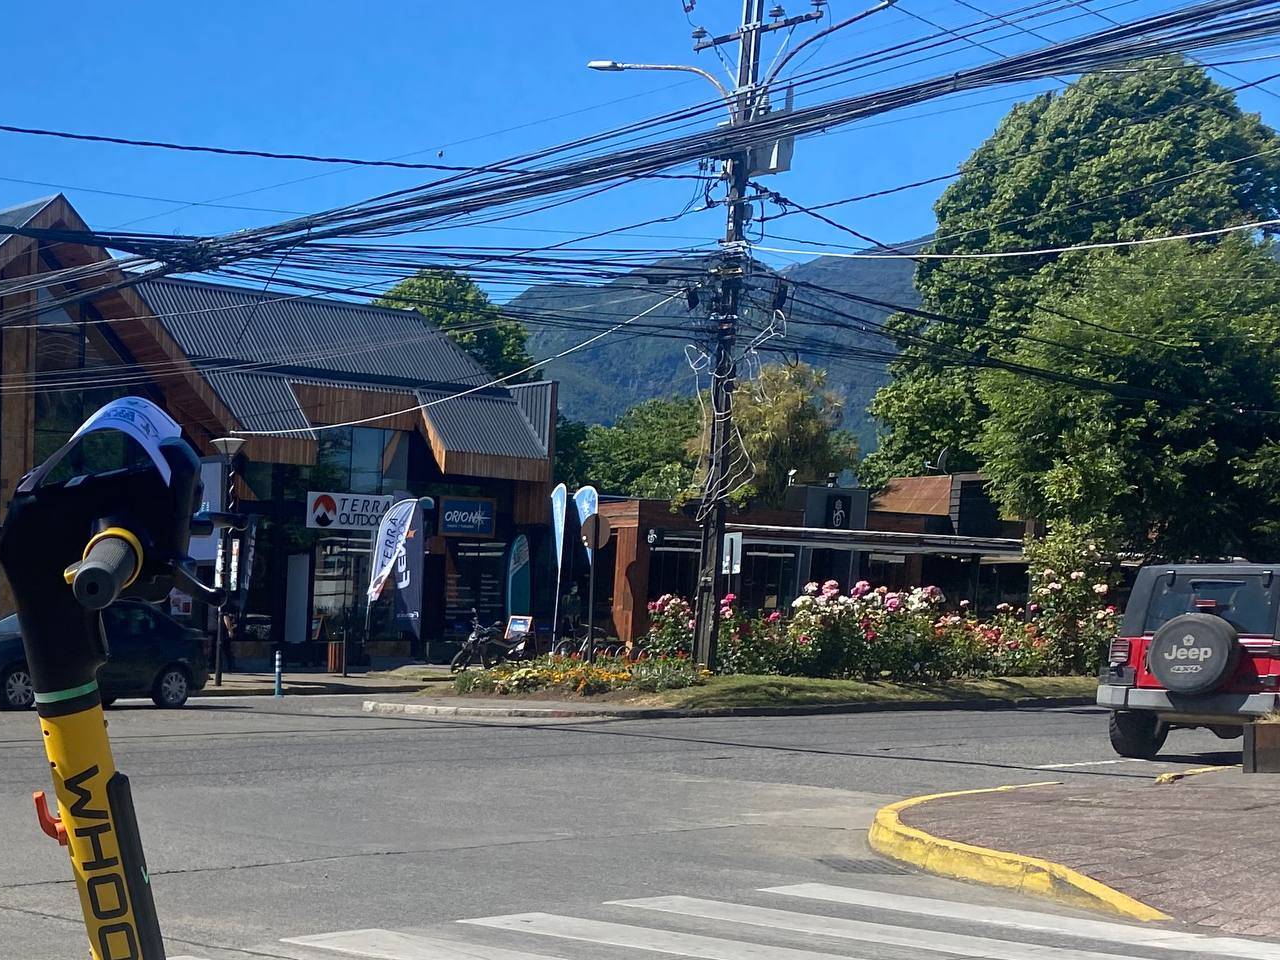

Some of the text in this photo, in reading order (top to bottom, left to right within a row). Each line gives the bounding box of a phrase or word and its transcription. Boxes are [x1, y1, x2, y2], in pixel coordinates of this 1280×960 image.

[340, 498, 391, 514] TERRA
[339, 512, 384, 527] OUTDOO
[1163, 644, 1213, 662] Jeep
